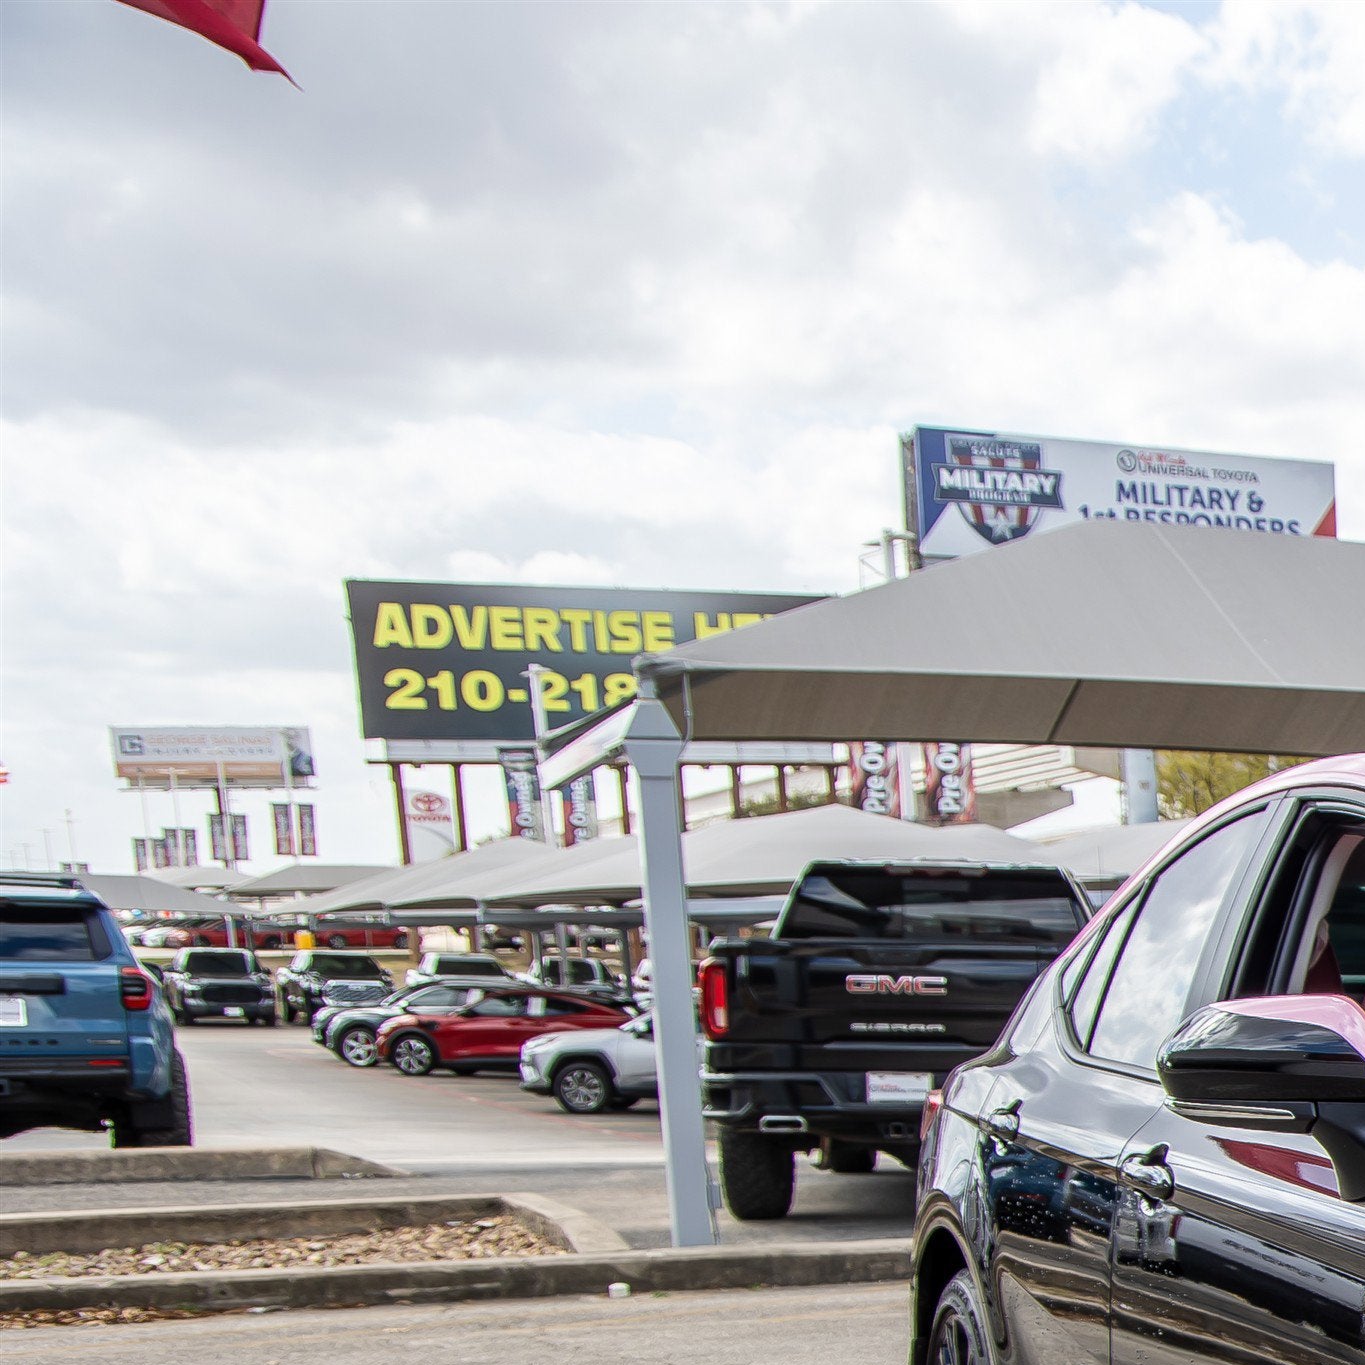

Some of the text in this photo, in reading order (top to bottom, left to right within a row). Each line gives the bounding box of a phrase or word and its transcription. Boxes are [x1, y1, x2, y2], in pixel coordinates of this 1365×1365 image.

[939, 467, 1057, 495] MILITARY
[1138, 463, 1261, 484] UNIVERSAL TOYOTA
[1116, 480, 1265, 514] MILITARY &
[374, 602, 676, 654] ADVERTISE
[938, 774, 961, 814] Pre
[846, 974, 948, 996] GMC
